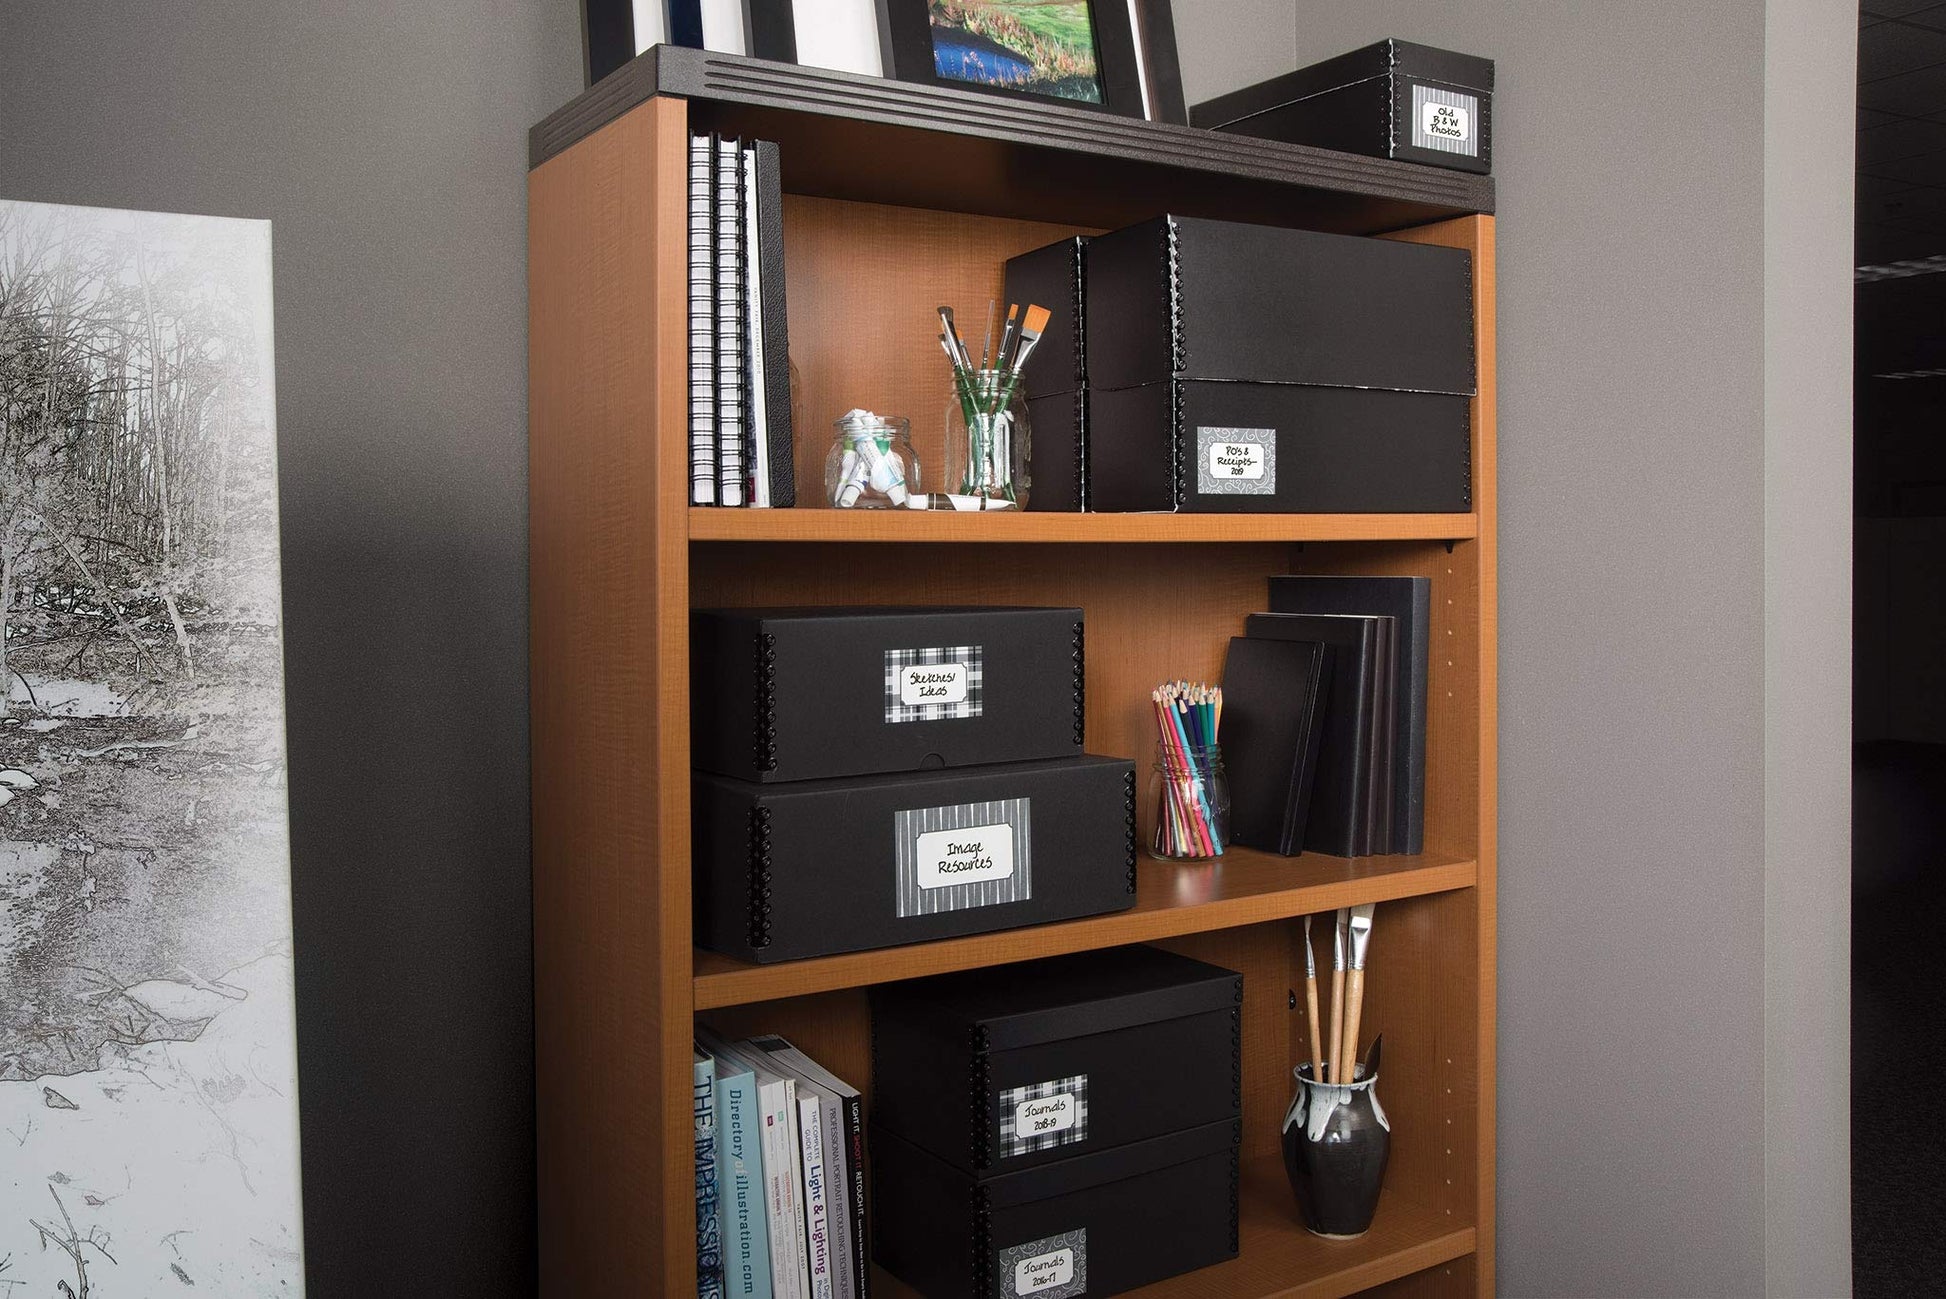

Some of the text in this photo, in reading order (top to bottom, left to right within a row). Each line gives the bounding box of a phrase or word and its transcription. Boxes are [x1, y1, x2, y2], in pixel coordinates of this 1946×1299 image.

[1433, 115, 1459, 126] B & W
[1438, 107, 1454, 117] Old
[1430, 123, 1461, 137] Photos
[1230, 467, 1244, 475] 2019
[919, 685, 947, 697] Ideas
[946, 842, 984, 858] Image
[938, 856, 993, 873] Resources
[694, 1075, 713, 1130] THE
[1024, 1100, 1066, 1118] Journals
[851, 1102, 859, 1124] LIGHT
[1034, 1117, 1057, 1131] 2018-19
[812, 1125, 820, 1159] COMPLETE
[853, 1135, 861, 1160] SHOOT
[806, 1153, 812, 1162] TO
[855, 1171, 863, 1207] RETOUCH
[829, 1108, 849, 1299] PROFESSIONAL PORTRAIT RETOUCHING TECHNIQUES
[808, 1165, 827, 1275] Light & Lighting
[1023, 1255, 1065, 1275] Journals
